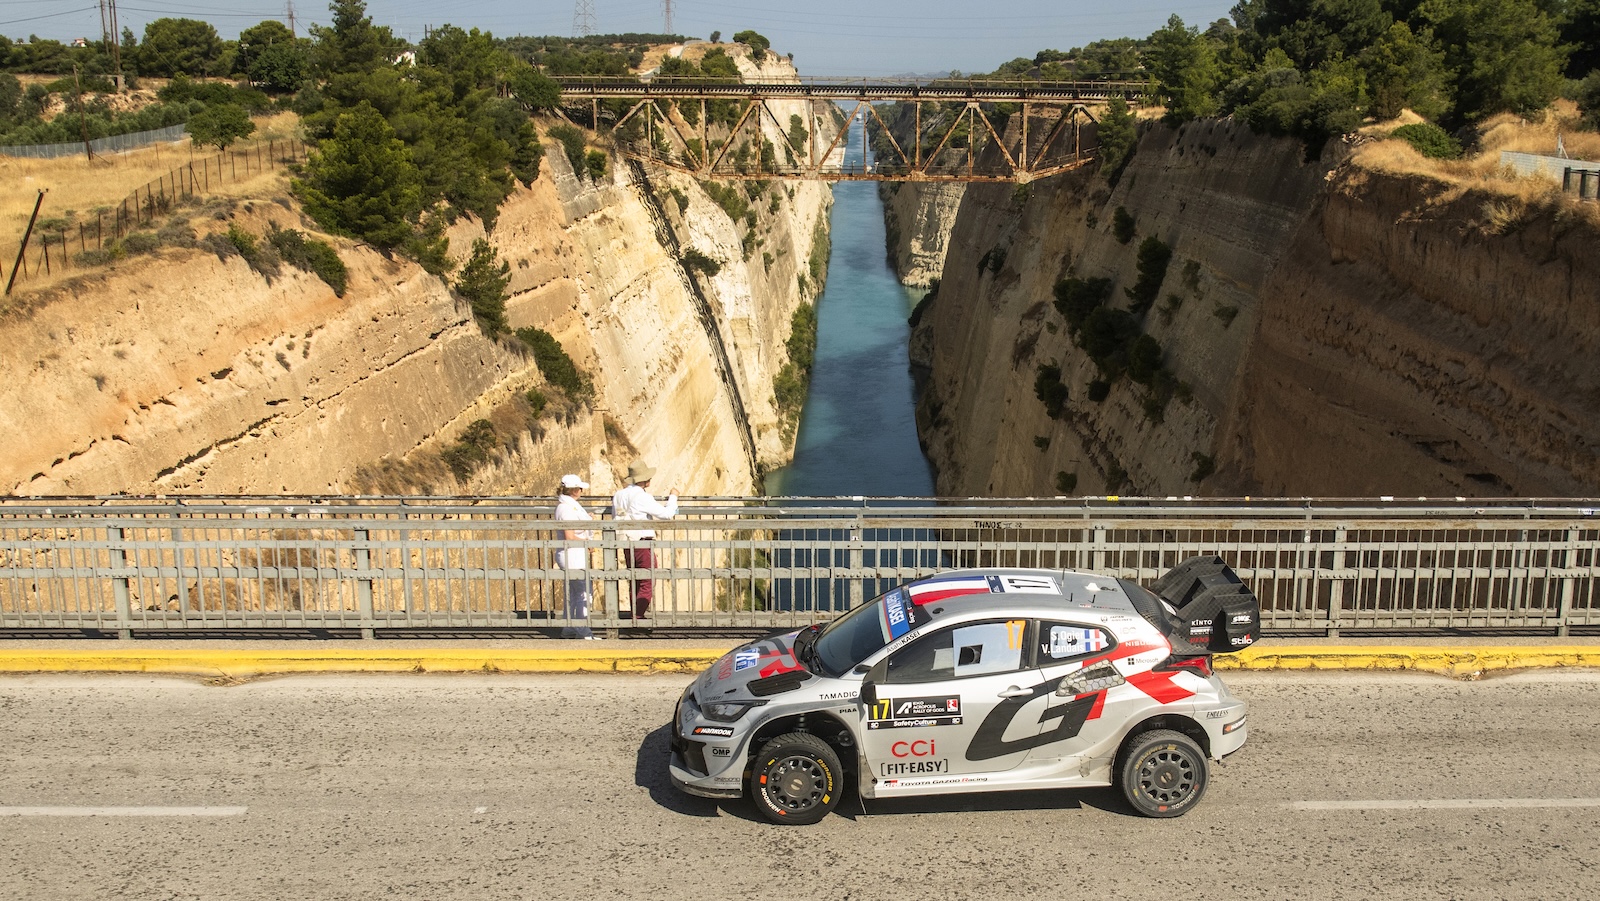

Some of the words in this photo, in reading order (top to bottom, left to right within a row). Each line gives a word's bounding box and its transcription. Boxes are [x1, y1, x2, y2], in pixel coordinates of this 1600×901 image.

[1005, 620, 1026, 650] 17
[819, 690, 858, 700] TAMADIC
[893, 719, 937, 727] SafetyCulture
[712, 748, 731, 756] OMP
